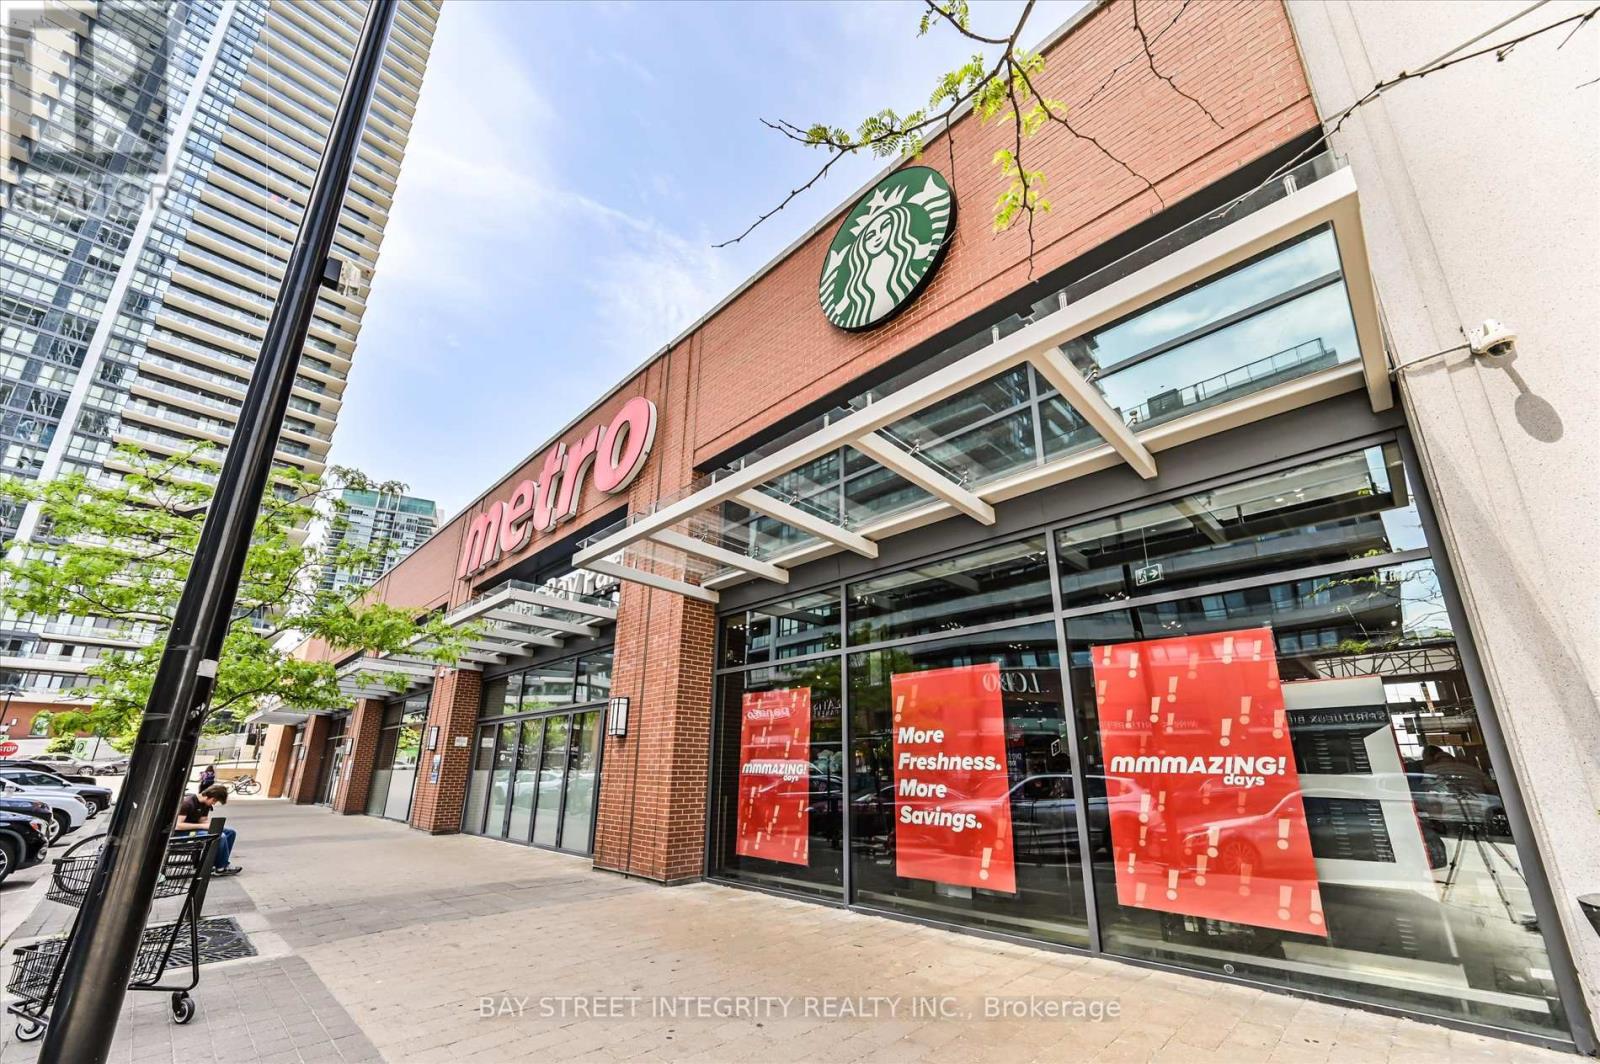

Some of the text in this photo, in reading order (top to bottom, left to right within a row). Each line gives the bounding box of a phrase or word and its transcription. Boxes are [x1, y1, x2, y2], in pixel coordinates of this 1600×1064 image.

[458, 396, 657, 581] metro
[898, 726, 945, 744] More
[898, 752, 1002, 771] Freshness.
[899, 778, 948, 798] More
[1223, 771, 1265, 788] days
[899, 805, 983, 832] Savings.
